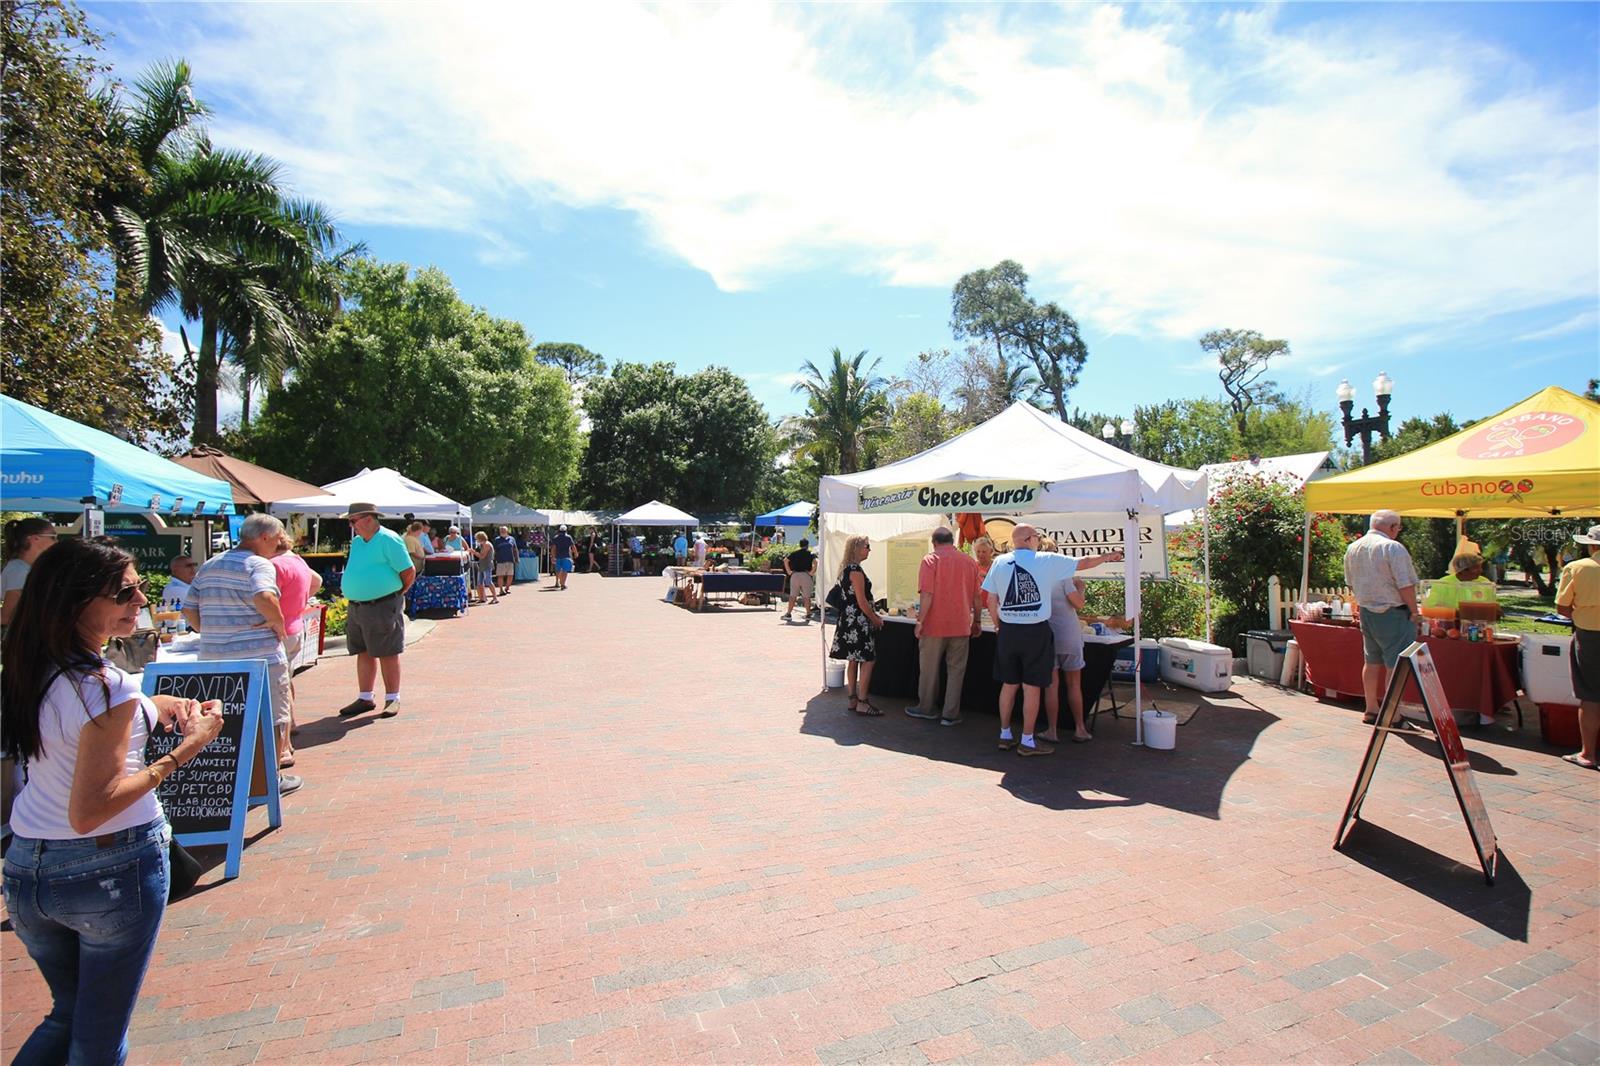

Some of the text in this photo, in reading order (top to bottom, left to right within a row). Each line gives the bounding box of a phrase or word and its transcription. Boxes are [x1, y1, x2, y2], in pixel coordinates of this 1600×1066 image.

[1420, 480, 1497, 497] Cubano
[131, 547, 166, 558] PARK
[1054, 545, 1143, 560] HEES
[1019, 592, 1040, 604] WIND
[223, 702, 247, 715] EMP
[152, 736, 177, 746] MAY
[186, 770, 236, 782] SUPPORT
[177, 797, 199, 806] LAB
